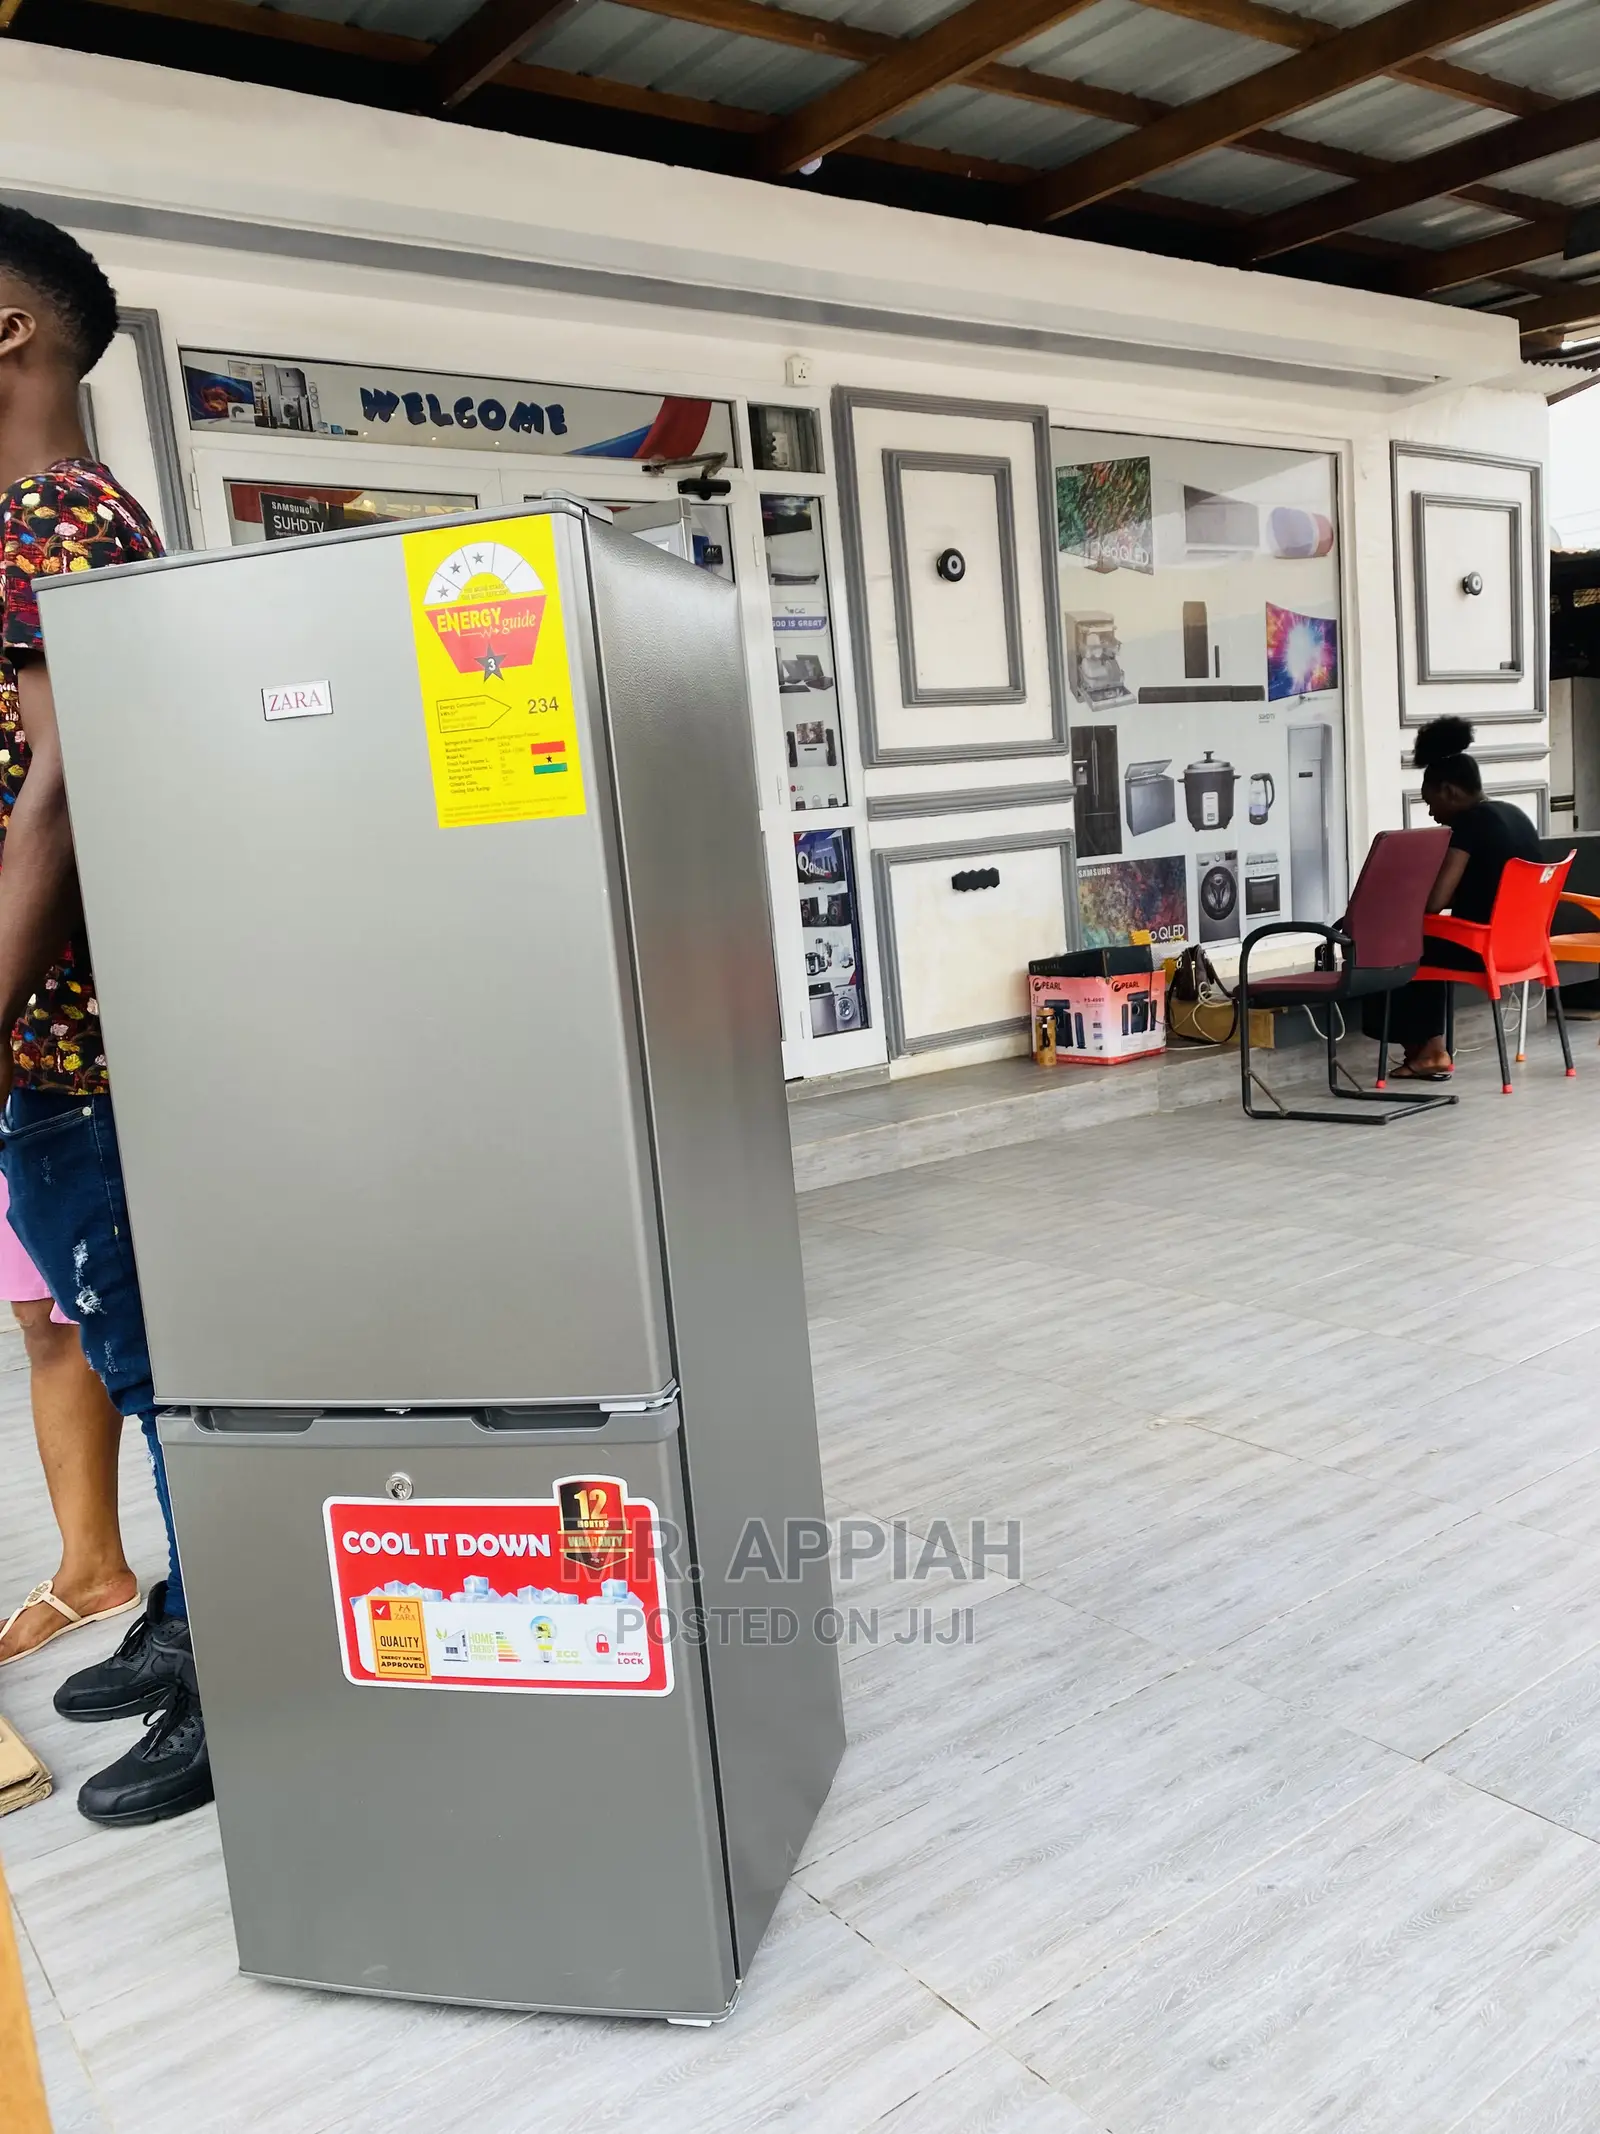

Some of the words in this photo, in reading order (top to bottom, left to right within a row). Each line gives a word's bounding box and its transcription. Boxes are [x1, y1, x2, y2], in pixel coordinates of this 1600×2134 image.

[359, 387, 568, 435] WELCOME
[271, 501, 310, 515] SAMSUNG
[436, 607, 501, 637] ENERGY
[502, 609, 536, 635] guide
[487, 658, 496, 671] 3
[268, 688, 323, 712] ZARA
[527, 696, 559, 714] 234
[1077, 867, 1111, 878] SAMSUNG
[574, 1489, 608, 1520] 12
[342, 1530, 420, 1555] COOL
[424, 1533, 449, 1556] IT
[455, 1533, 551, 1557] DOWN
[567, 1536, 623, 1548] WARRANTY
[394, 1613, 416, 1621] ZARA
[380, 1636, 419, 1648] QUALITY
[555, 1650, 578, 1658] ECO
[381, 1661, 425, 1669] APPROVED
